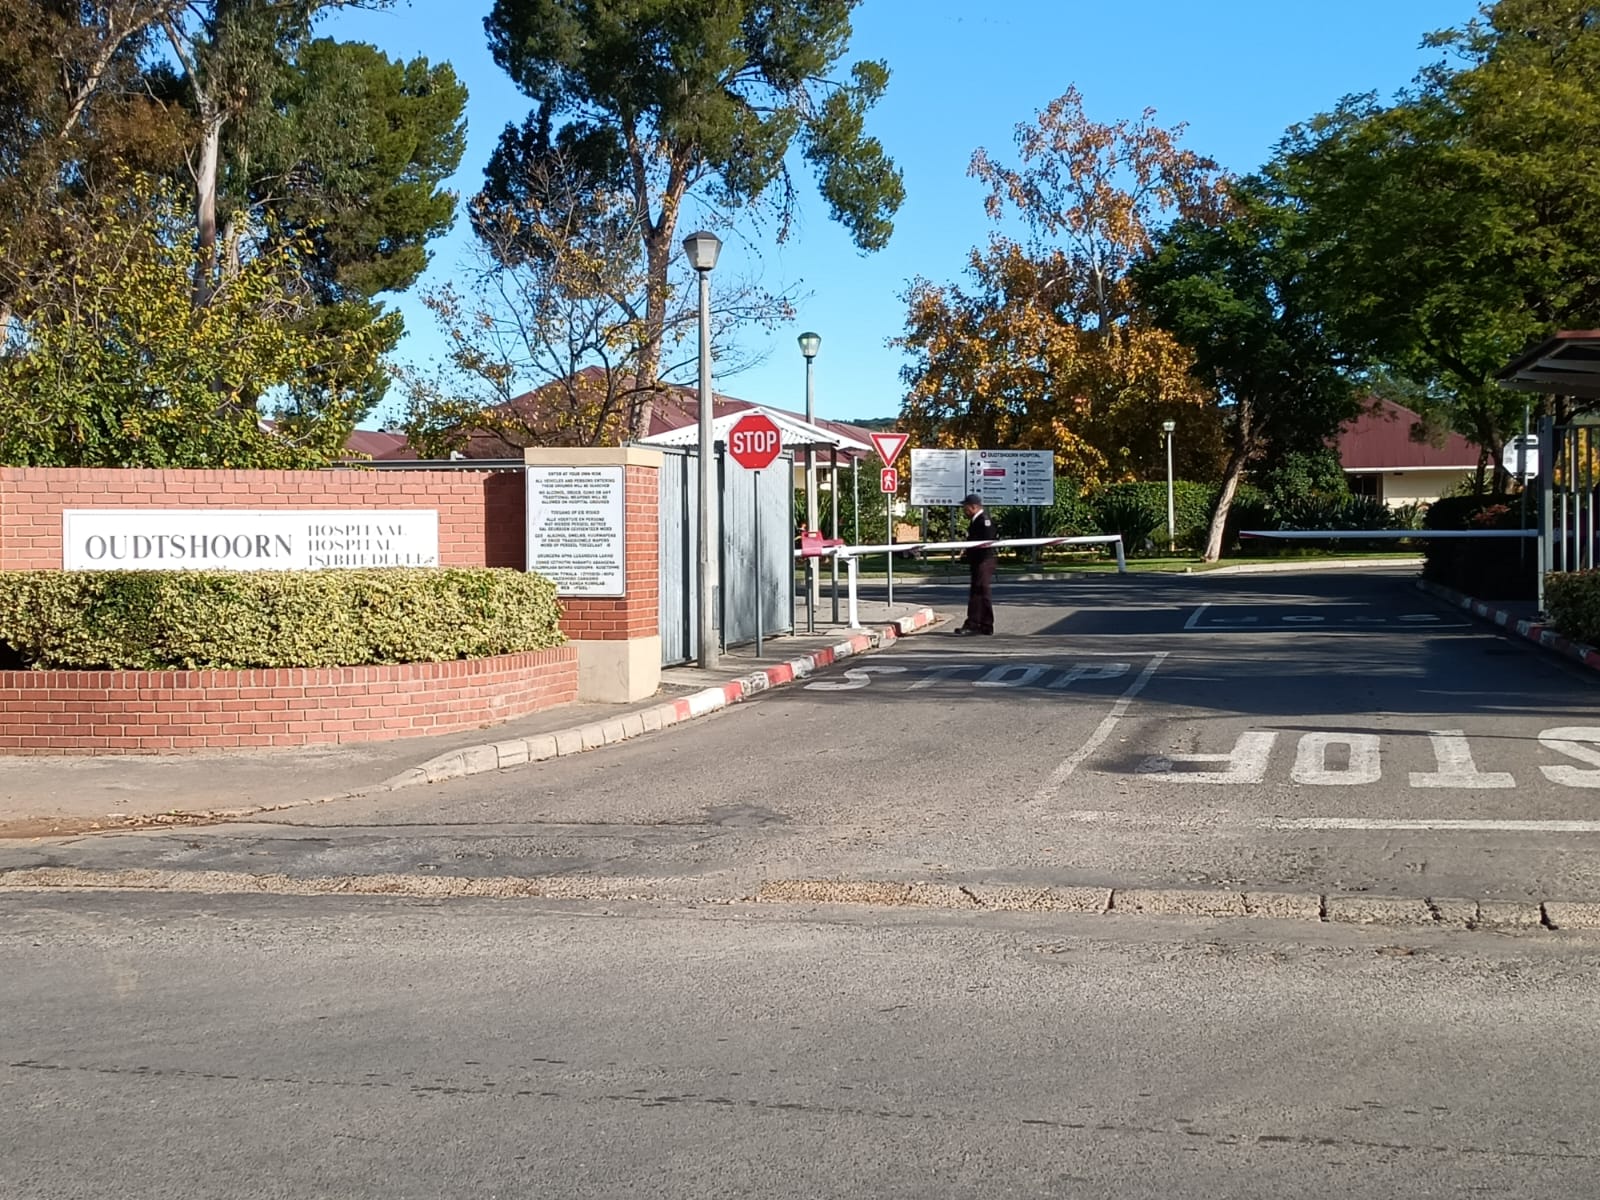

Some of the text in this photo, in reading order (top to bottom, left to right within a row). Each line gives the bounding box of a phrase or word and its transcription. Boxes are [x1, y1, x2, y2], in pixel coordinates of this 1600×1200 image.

[733, 431, 777, 454] STOP
[308, 524, 407, 537] HOSPITAAL
[85, 534, 293, 560] OUDTSHOORN
[308, 538, 395, 551] HOSPITAL
[802, 662, 1131, 690] STOP
